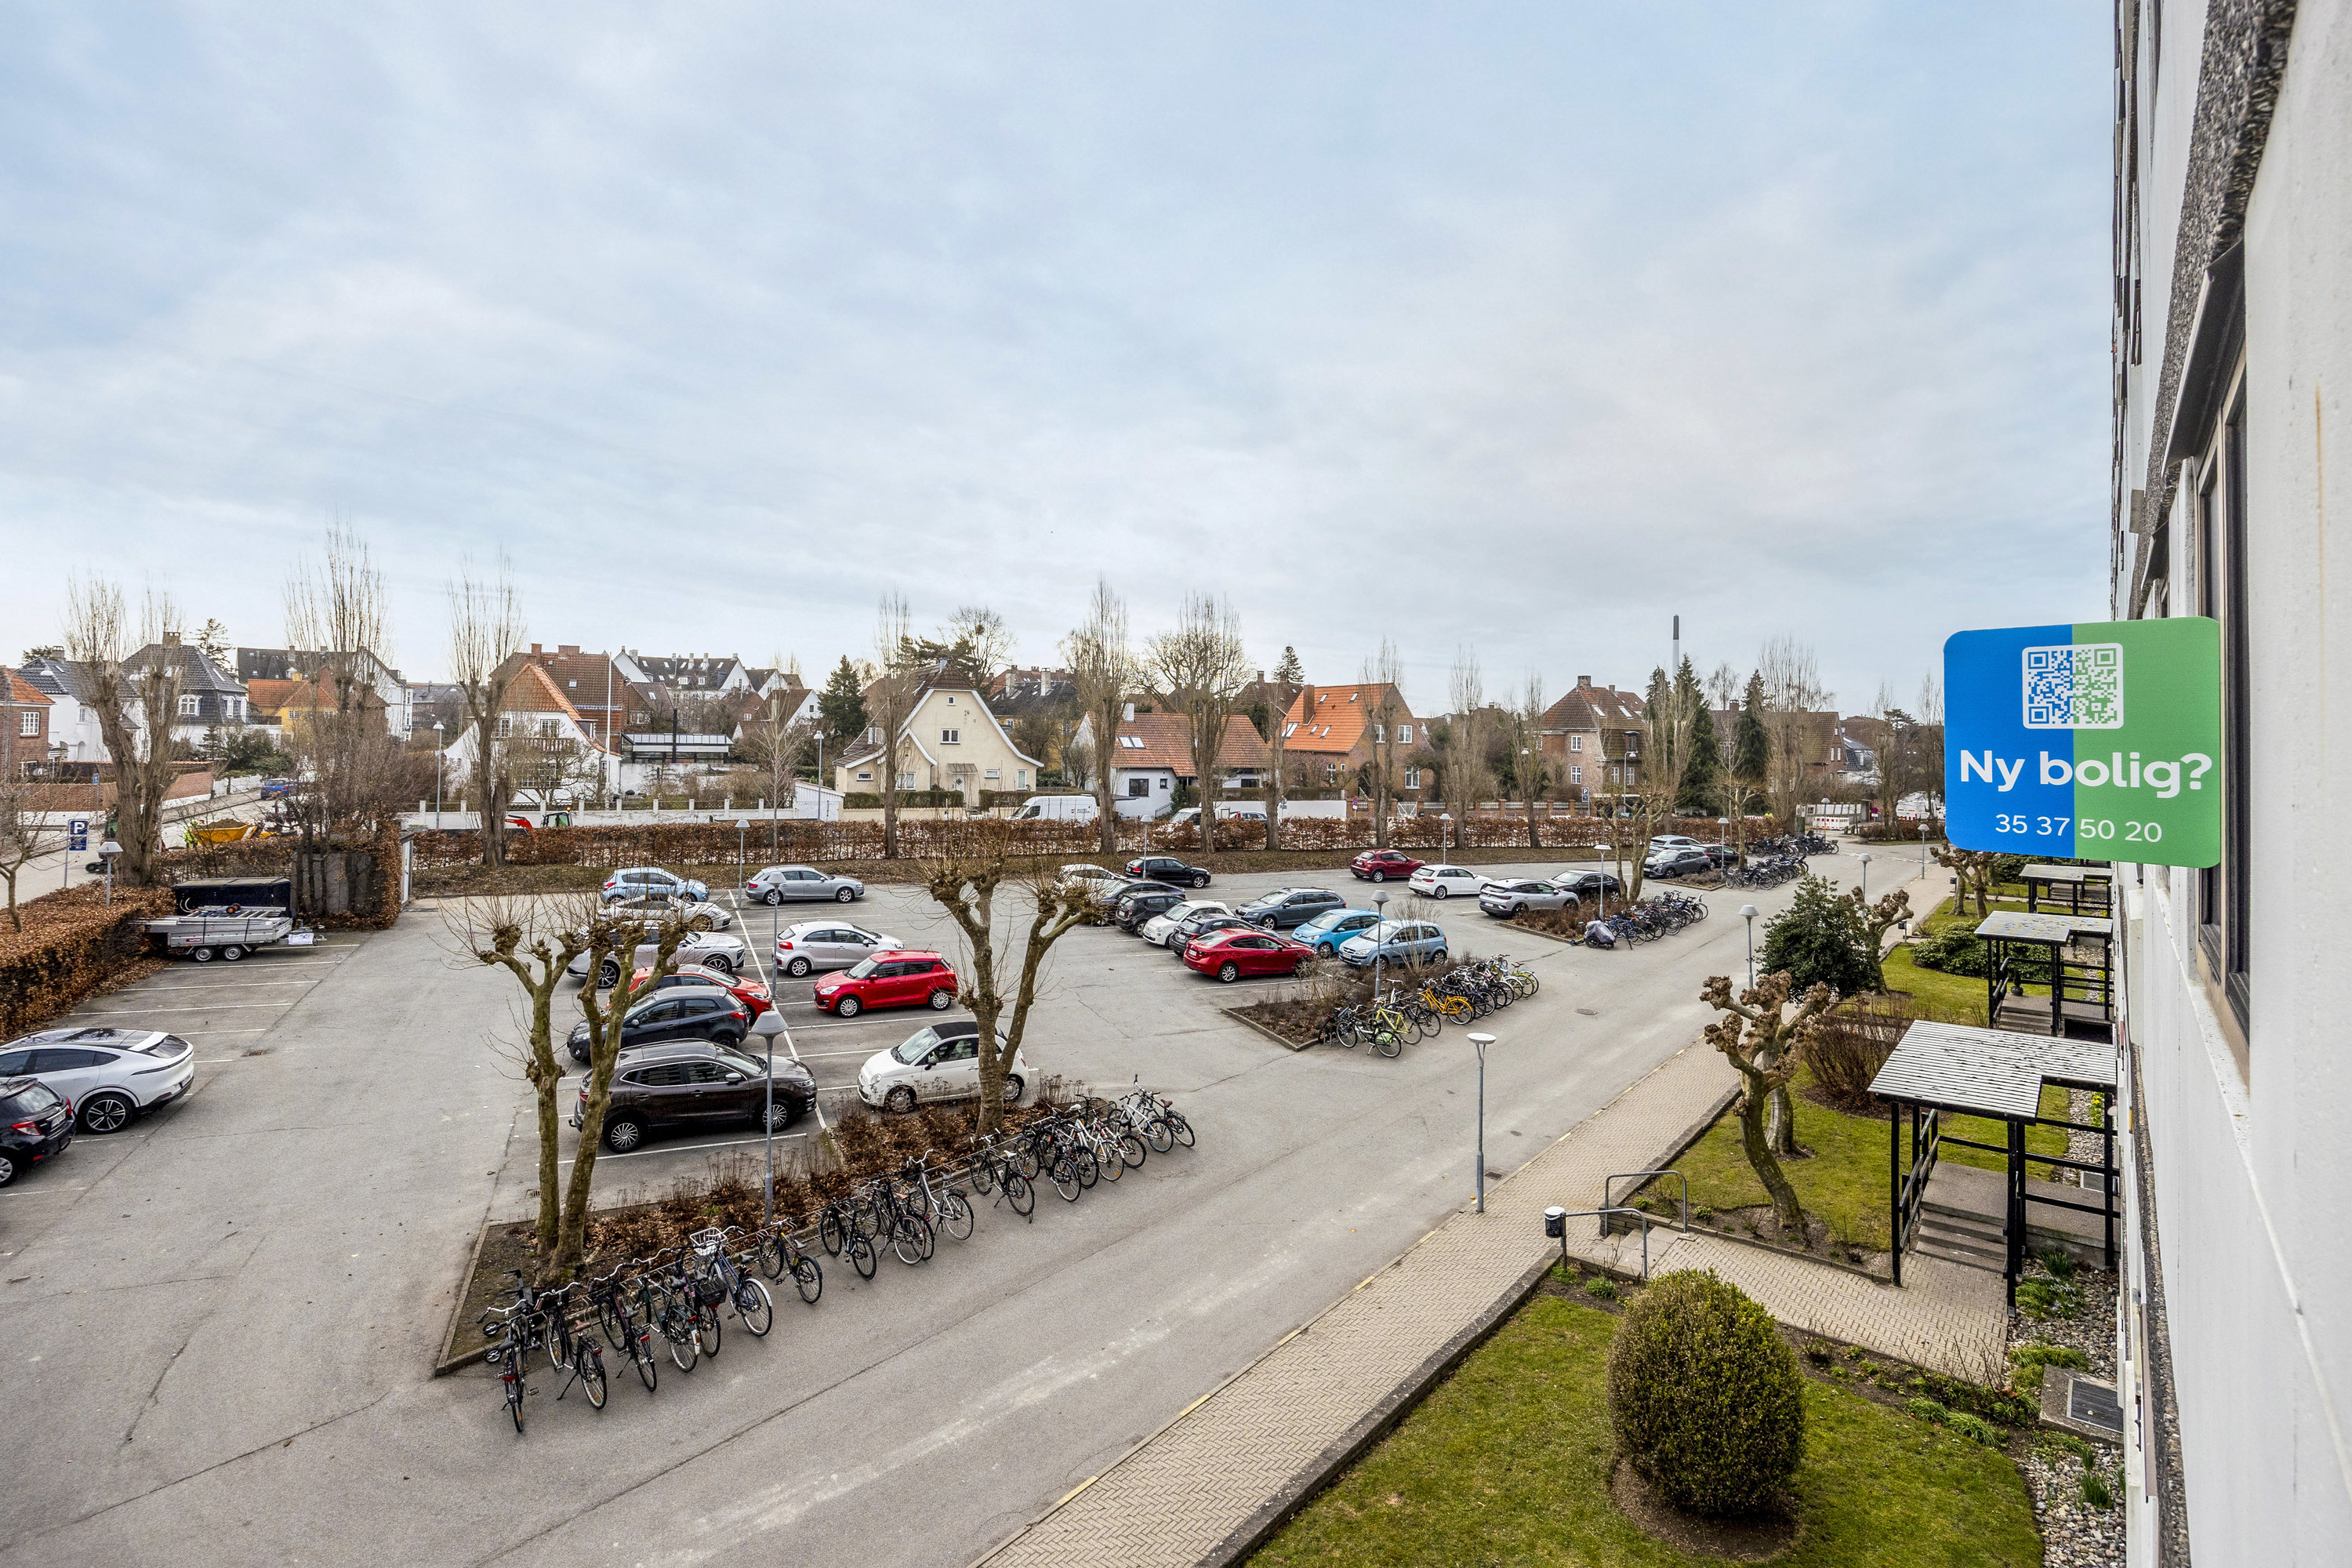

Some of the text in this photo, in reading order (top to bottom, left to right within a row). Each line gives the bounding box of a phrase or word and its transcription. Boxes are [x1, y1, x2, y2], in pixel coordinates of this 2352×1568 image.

[1960, 750, 2213, 799] Ny bolig?
[74, 822, 85, 834] P
[1995, 814, 2162, 843] 35 37 50 20
